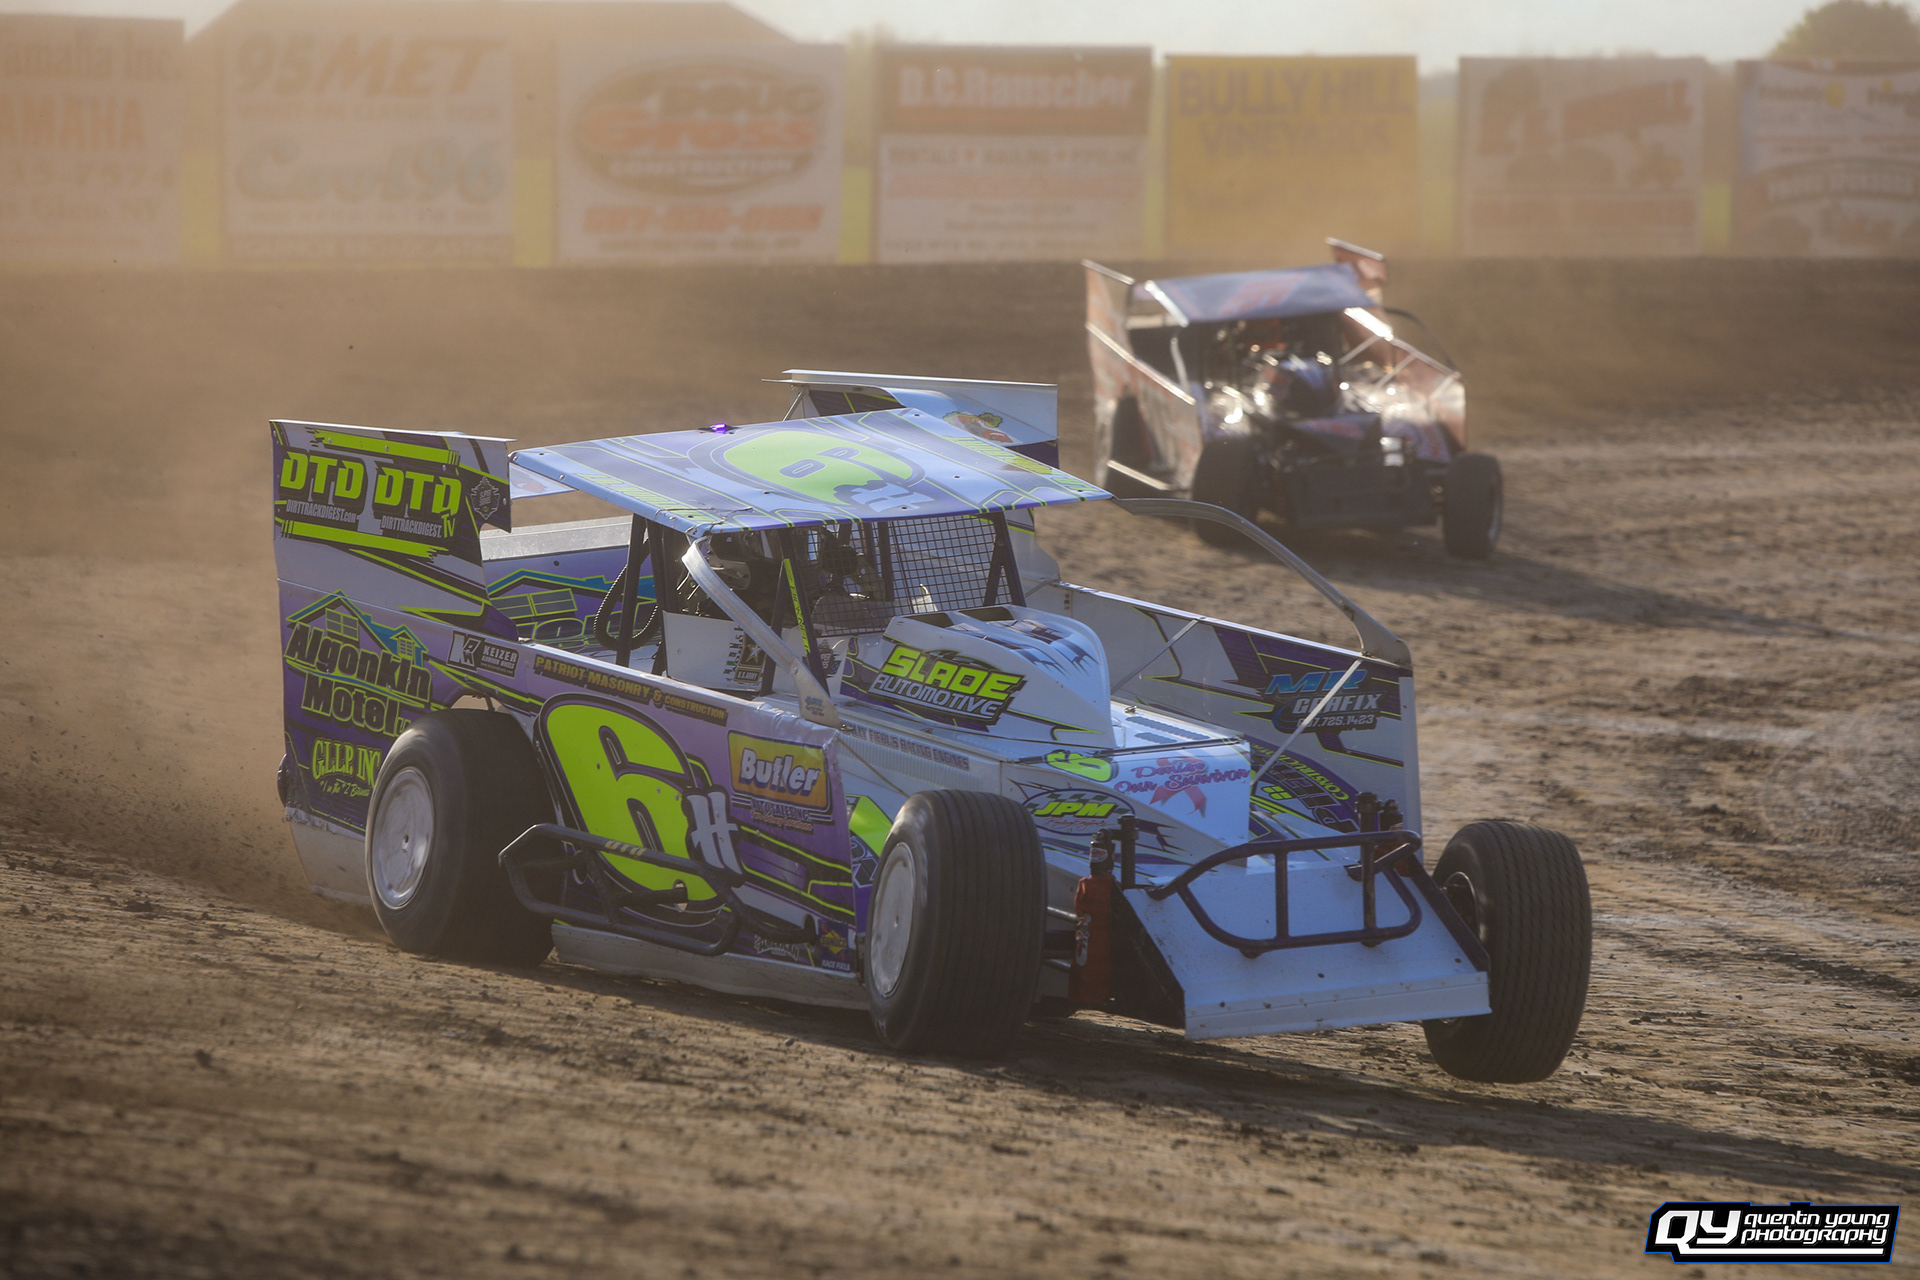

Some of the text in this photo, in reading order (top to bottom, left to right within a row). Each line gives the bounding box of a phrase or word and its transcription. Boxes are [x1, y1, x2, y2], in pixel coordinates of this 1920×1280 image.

[3, 30, 111, 77] amaha
[1178, 68, 1414, 117] BULLY HILL
[0, 94, 146, 150] AMAHA
[1198, 119, 1393, 158] VINEYARDS
[608, 159, 793, 178] CONSTRUCTION
[280, 451, 462, 515] DTD DTD
[483, 645, 518, 662] KEIZER
[881, 646, 1026, 701] SLADE
[301, 674, 399, 737] Motel
[534, 656, 727, 721] PATRIOT MASONRY & CONSTRUCTION
[872, 674, 1004, 718] AUTOMOTIVE
[1297, 714, 1376, 728] 67.725.1423
[740, 748, 822, 792] Butler
[933, 748, 970, 771] ENGINES
[1131, 760, 1207, 779] Denise
[1034, 802, 1115, 817] JPM
[1114, 780, 1158, 795] Our
[1251, 755, 1361, 834] PIER
